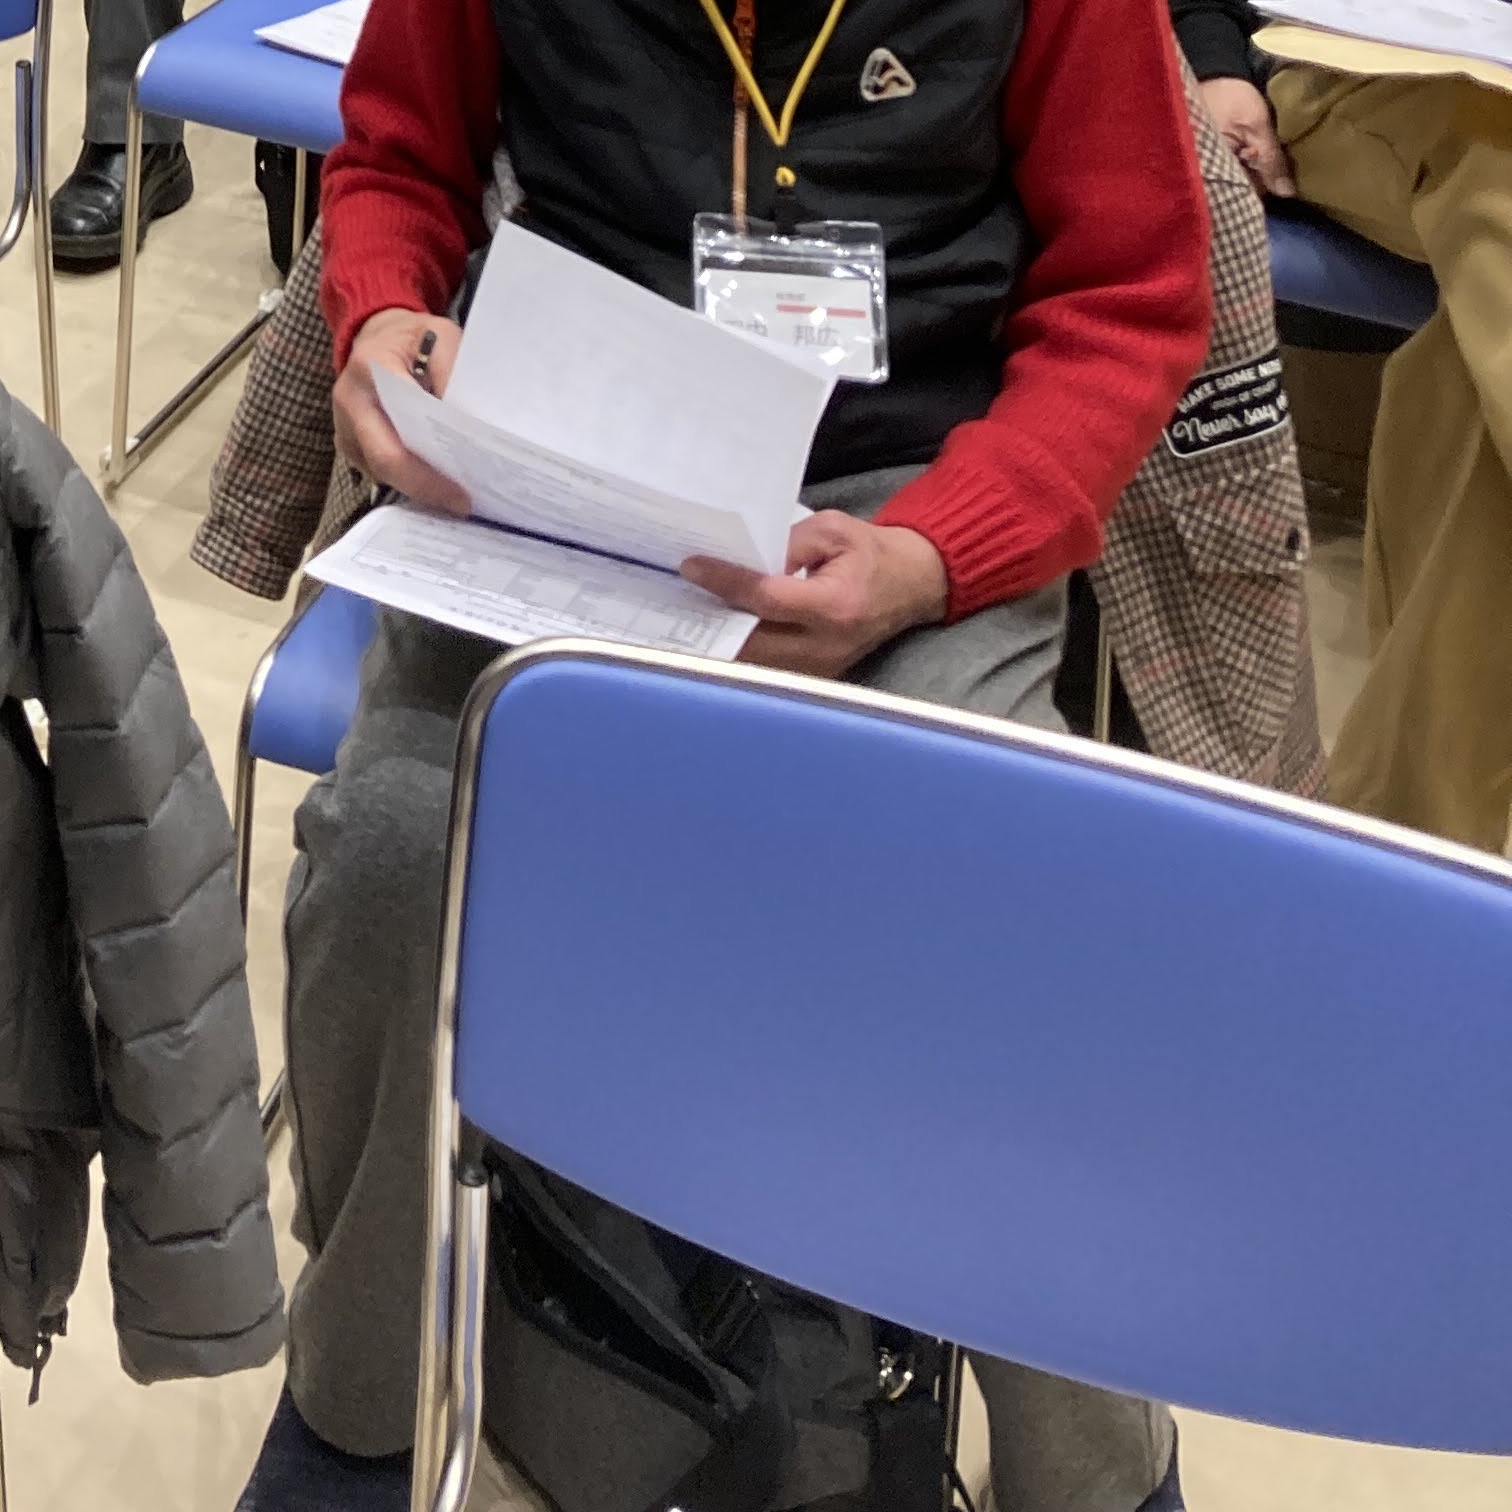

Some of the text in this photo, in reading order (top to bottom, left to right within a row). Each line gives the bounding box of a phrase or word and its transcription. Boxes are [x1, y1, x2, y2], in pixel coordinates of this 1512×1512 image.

[1178, 382, 1215, 413] MAKE
[1216, 368, 1256, 390] SOME
[1173, 404, 1278, 442] Never say
